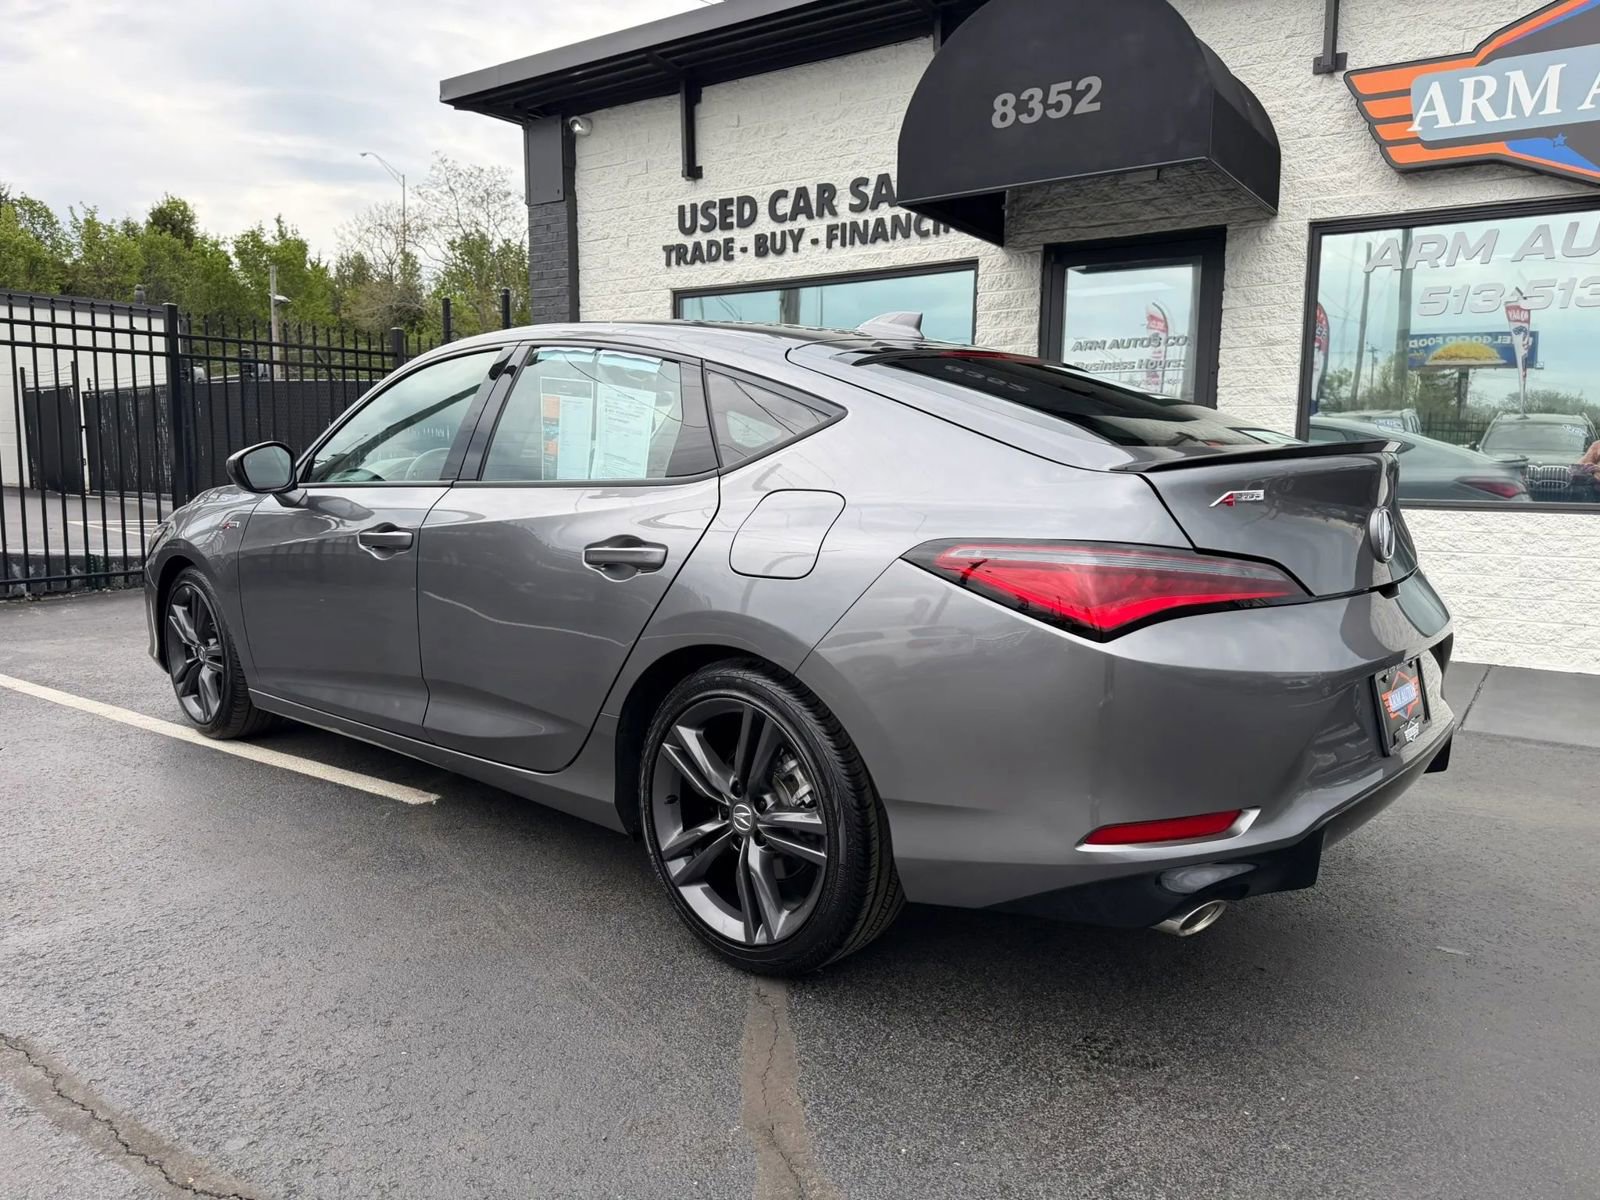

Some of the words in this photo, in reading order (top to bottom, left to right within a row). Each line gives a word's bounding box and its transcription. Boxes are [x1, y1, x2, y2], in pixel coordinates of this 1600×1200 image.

[991, 75, 1102, 129] 8352
[1406, 63, 1567, 132] ARM
[677, 195, 758, 236] USED
[768, 182, 838, 224] CAR
[849, 172, 898, 214] SA
[662, 237, 735, 267] TRADE
[754, 227, 806, 258] BUY
[825, 212, 950, 250] FINANCI
[1363, 228, 1500, 274] ARM
[1511, 221, 1600, 262] AU
[1418, 276, 1600, 316] 513-513
[1071, 340, 1107, 352] ARM
[1107, 336, 1162, 350] AUTOS
